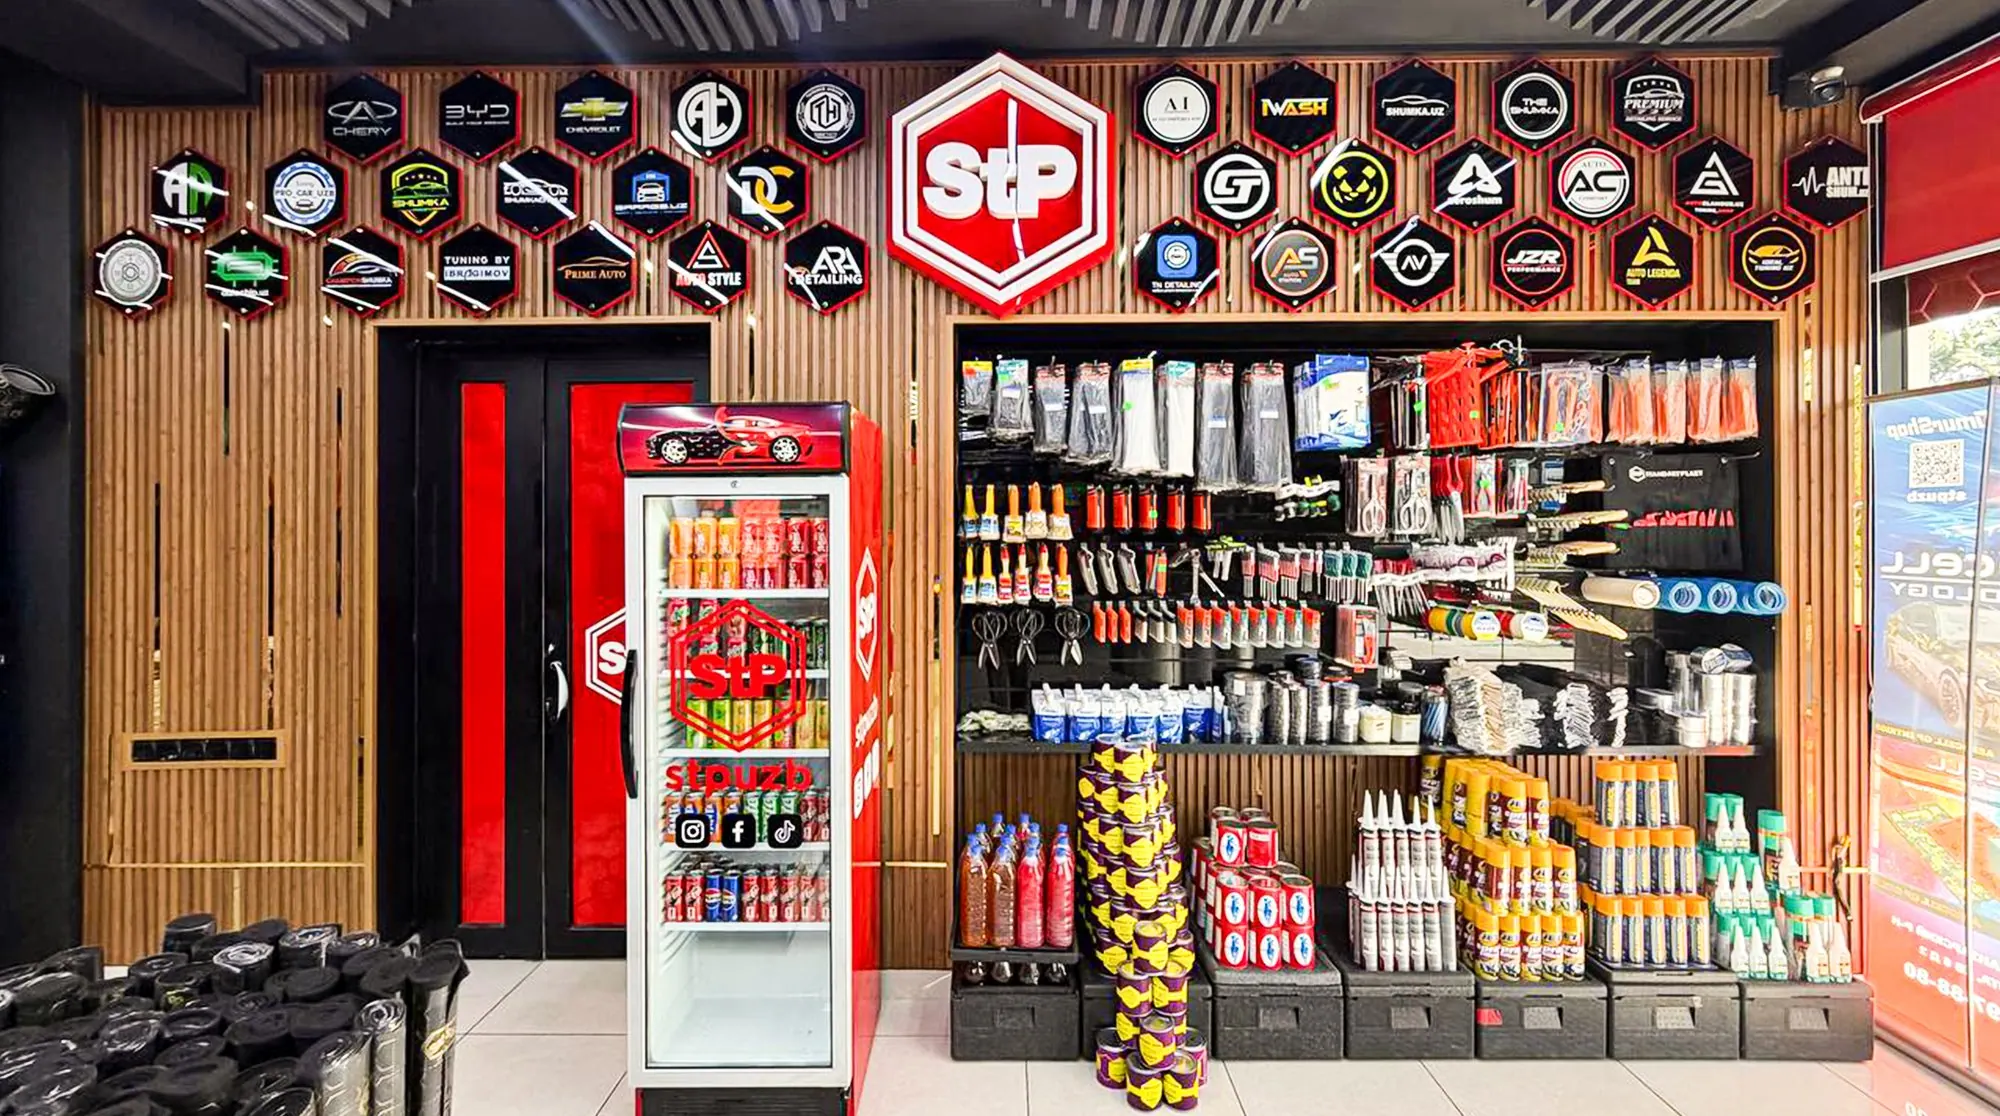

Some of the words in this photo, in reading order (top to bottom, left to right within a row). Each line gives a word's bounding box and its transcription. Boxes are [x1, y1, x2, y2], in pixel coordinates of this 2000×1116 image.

[1261, 98, 1329, 117] IWASH
[1522, 98, 1548, 106] THE
[1624, 99, 1684, 109] PREMIUM
[445, 105, 510, 119] BYD
[1386, 107, 1445, 116] SHUMKA.UZ
[1510, 107, 1559, 115] SHUMKA
[333, 127, 392, 136] CHERY
[922, 141, 1078, 220] StP
[392, 198, 450, 208] SHUMKA
[444, 256, 489, 265] TUNING
[495, 256, 510, 264] BY
[1507, 250, 1561, 264] JZR
[707, 272, 741, 286] STYLE
[690, 654, 787, 699] StP
[665, 758, 813, 797] stpuzb
